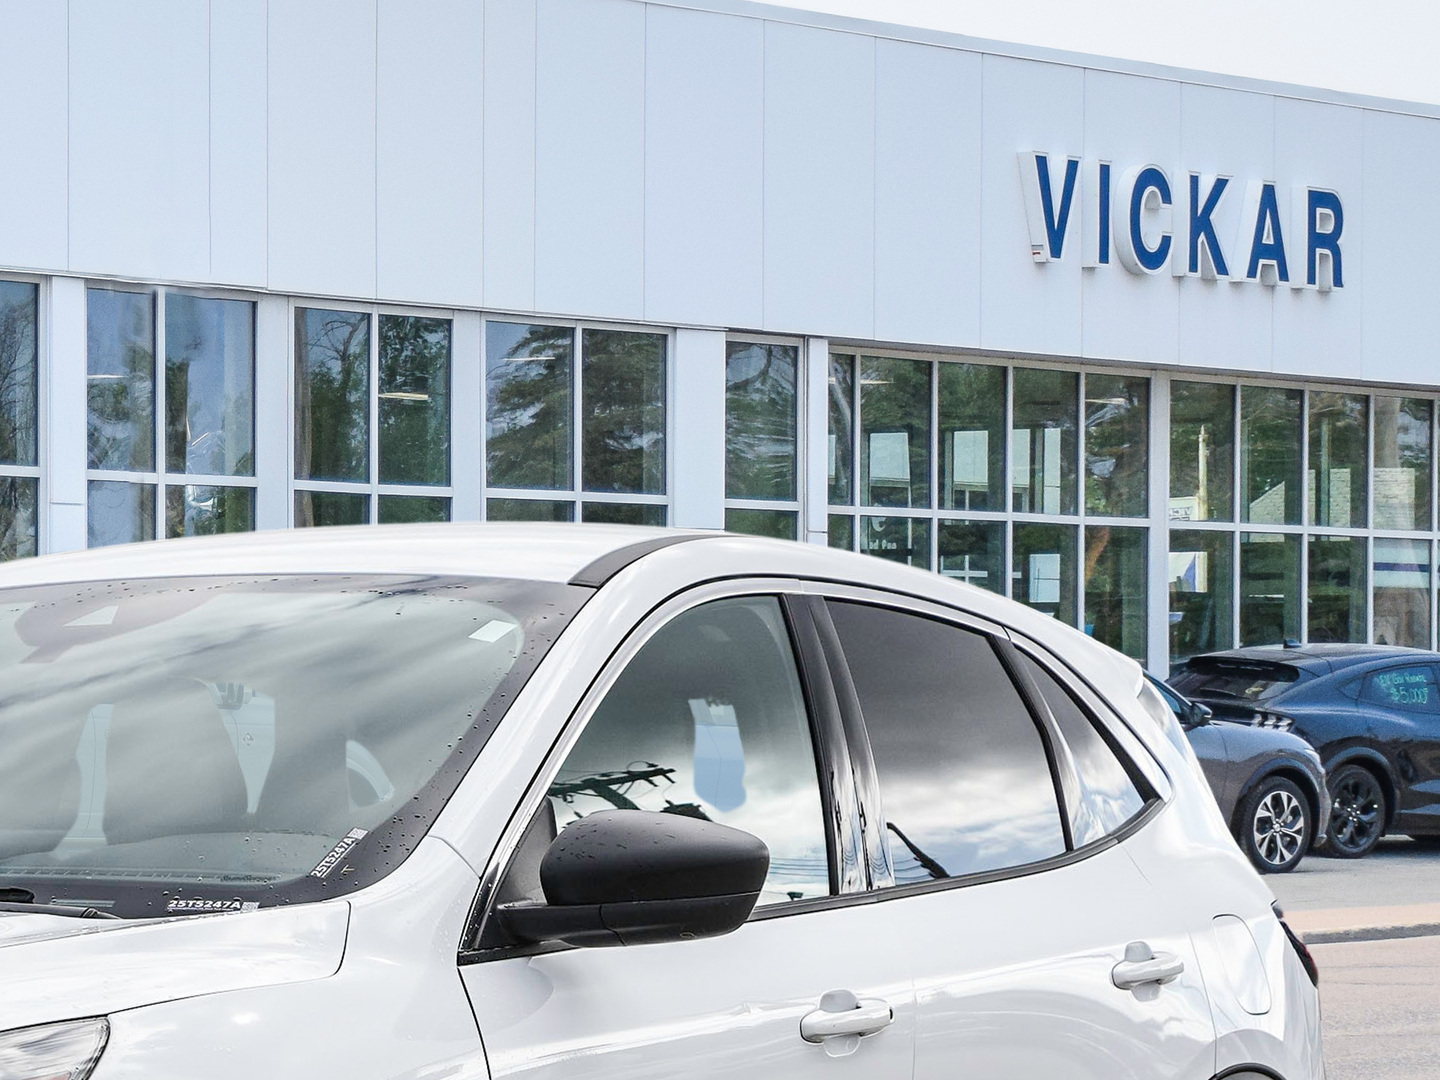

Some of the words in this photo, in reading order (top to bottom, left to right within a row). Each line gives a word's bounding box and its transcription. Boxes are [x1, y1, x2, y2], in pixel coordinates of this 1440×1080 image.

[1018, 150, 1347, 292] VICKAR
[310, 837, 356, 878] 25T5247A
[167, 900, 241, 910] 25T5247A
